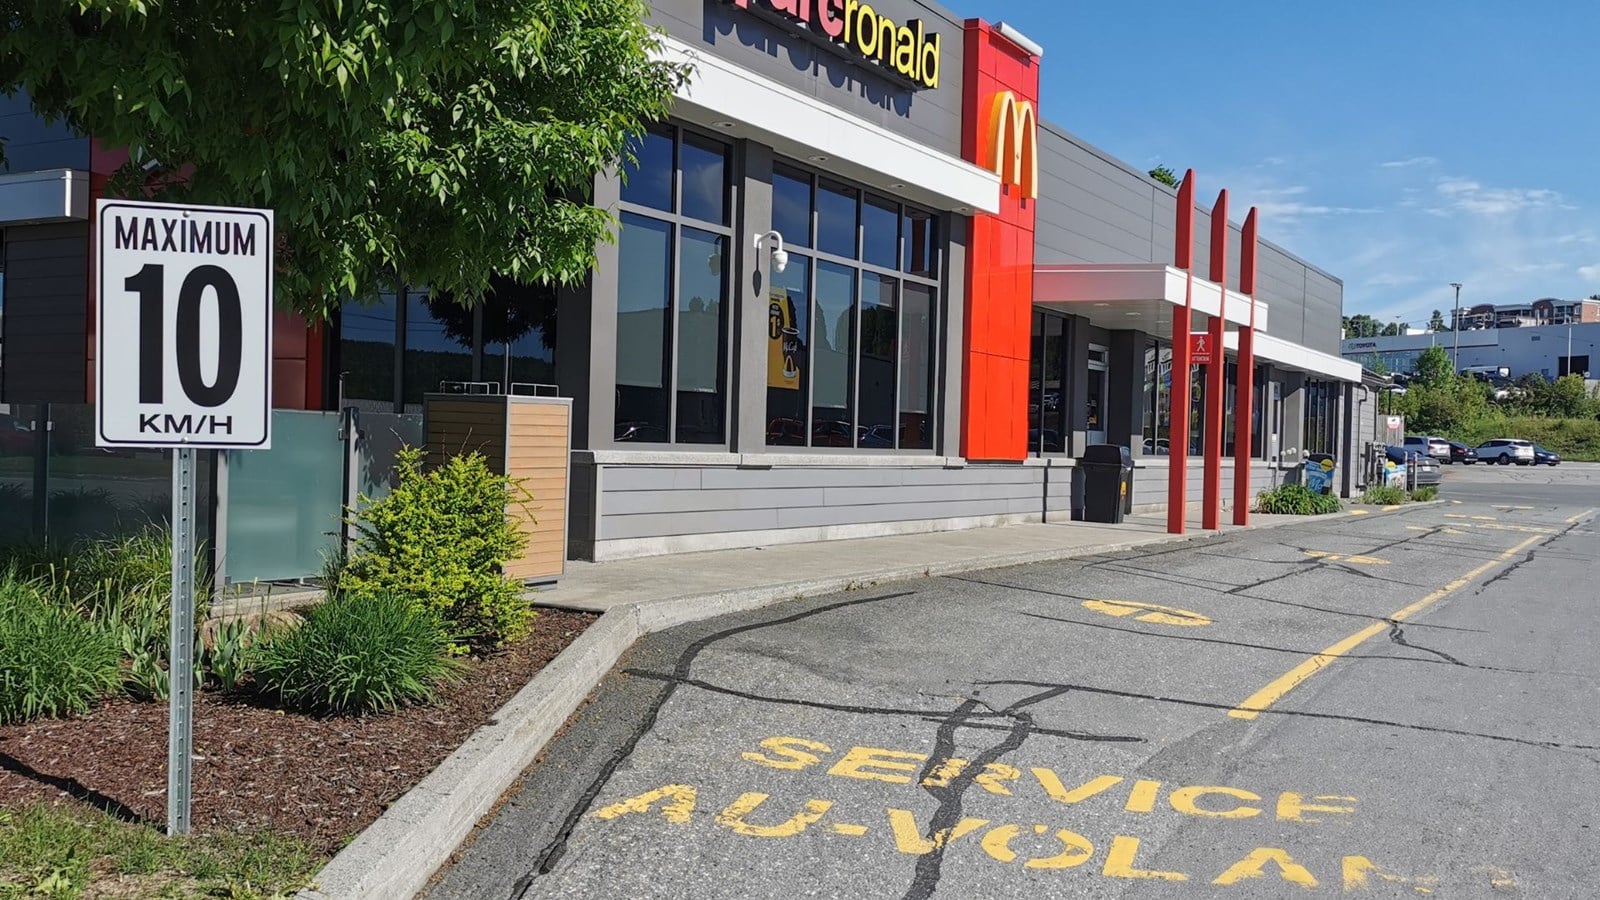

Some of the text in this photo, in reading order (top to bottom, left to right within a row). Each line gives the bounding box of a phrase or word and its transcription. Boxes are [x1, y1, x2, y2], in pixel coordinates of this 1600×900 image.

[115, 215, 256, 256] MAXIMUM
[124, 263, 243, 408] 10
[139, 413, 233, 435] KM/H
[742, 736, 1357, 824] SERVICE
[594, 784, 1517, 895] AU-VOLAN
